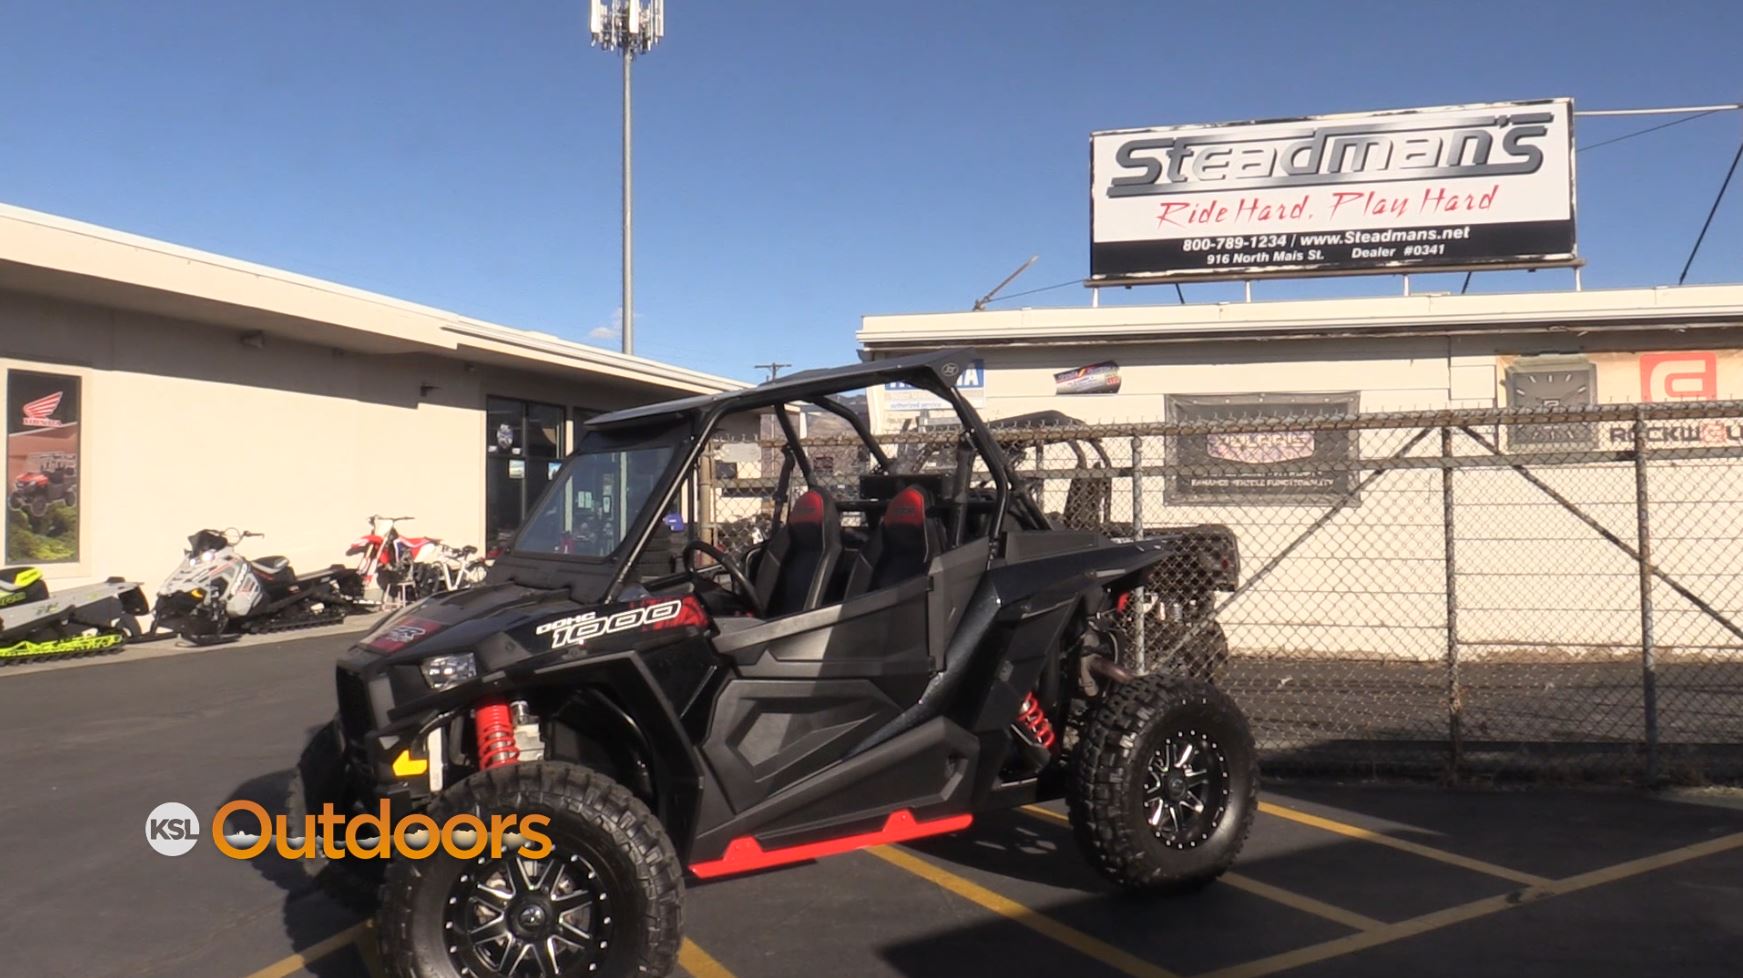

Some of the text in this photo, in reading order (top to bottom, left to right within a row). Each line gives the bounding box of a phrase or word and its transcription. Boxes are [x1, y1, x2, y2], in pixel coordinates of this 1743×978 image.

[1106, 112, 1555, 198] Steadman's
[1157, 184, 1499, 229] Ride Hard. Play Hard
[1183, 234, 1287, 251] 800-789-1234
[1300, 226, 1470, 247] www.Steadmans.net
[1351, 244, 1446, 259] Dealer #0341
[1207, 254, 1230, 265] 916
[1232, 252, 1269, 263] North
[1307, 249, 1325, 261] St.
[551, 600, 681, 649] 1000
